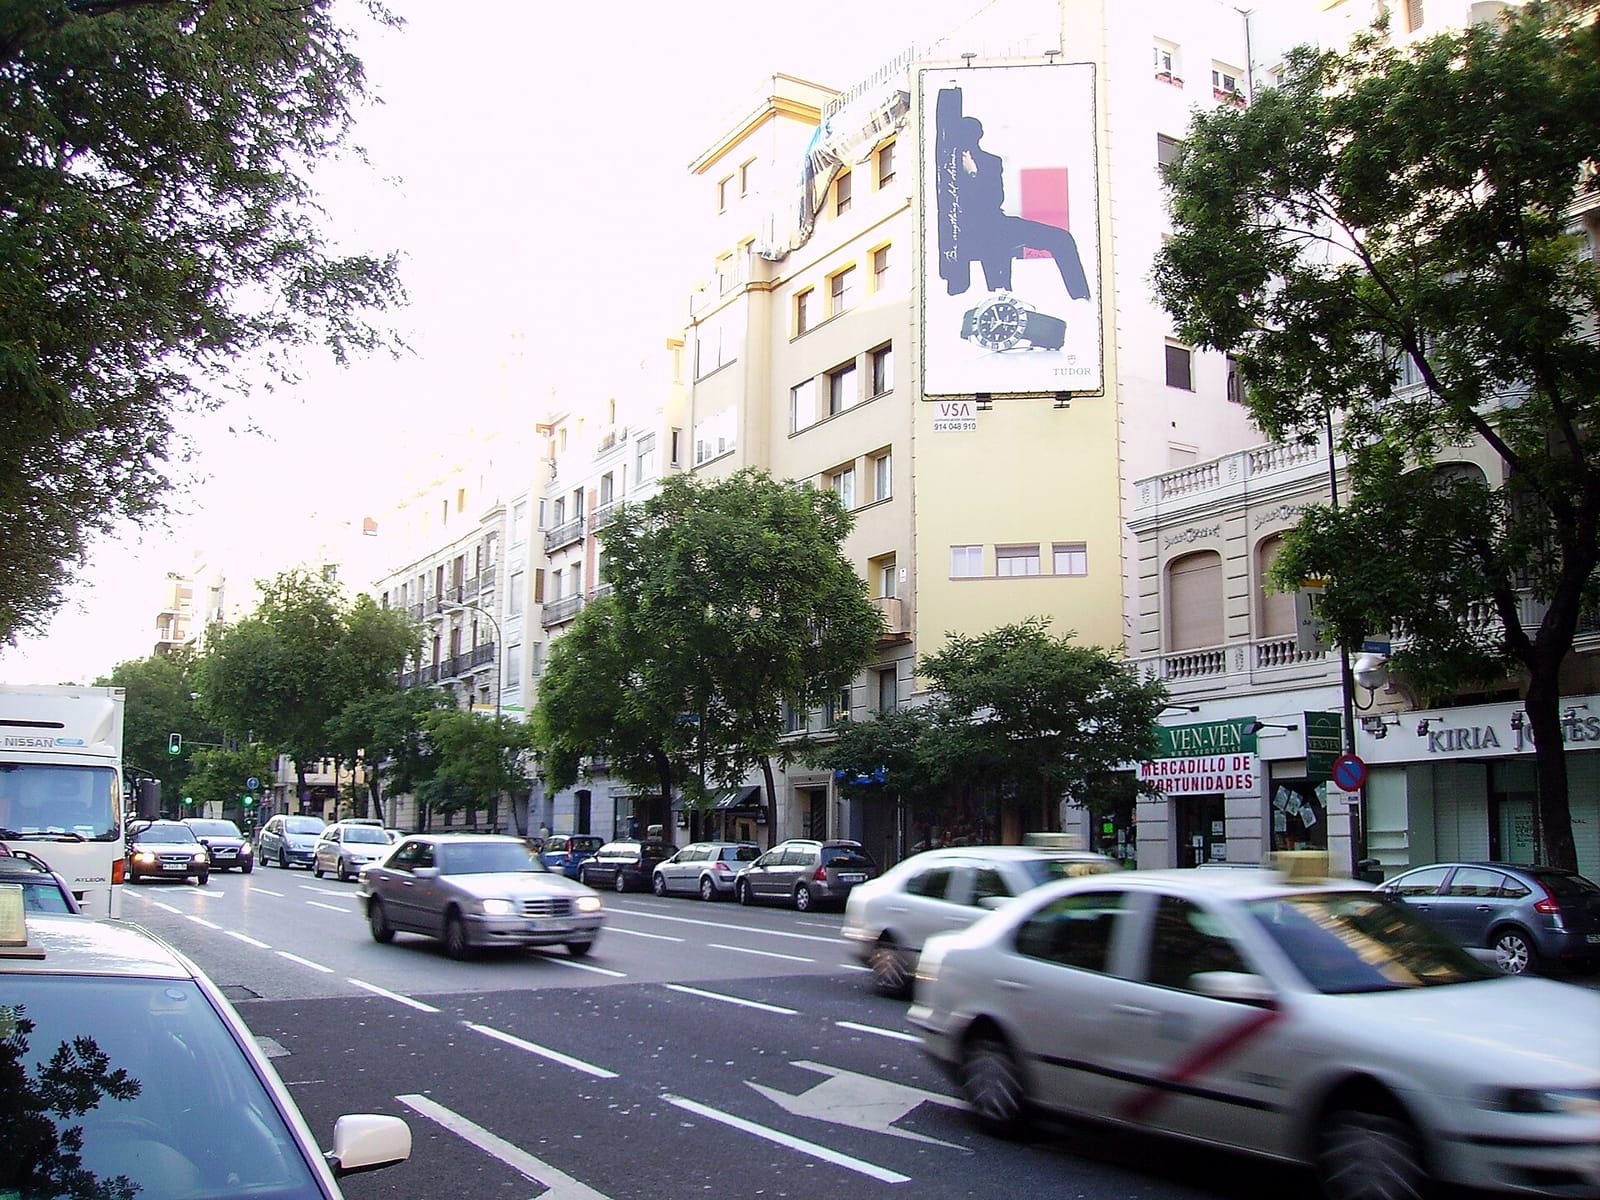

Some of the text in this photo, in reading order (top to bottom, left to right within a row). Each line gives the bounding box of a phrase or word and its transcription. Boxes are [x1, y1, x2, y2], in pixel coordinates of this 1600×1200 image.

[1052, 367, 1092, 376] TUDOR
[940, 402, 970, 417] VSA
[948, 422, 961, 430] 048
[963, 422, 976, 430] 910
[5, 737, 53, 748] NISSAN
[1427, 725, 1501, 752] KIRIA
[1141, 756, 1250, 777] MERCADILLO DE
[1146, 774, 1253, 793] PORTUNIDADES
